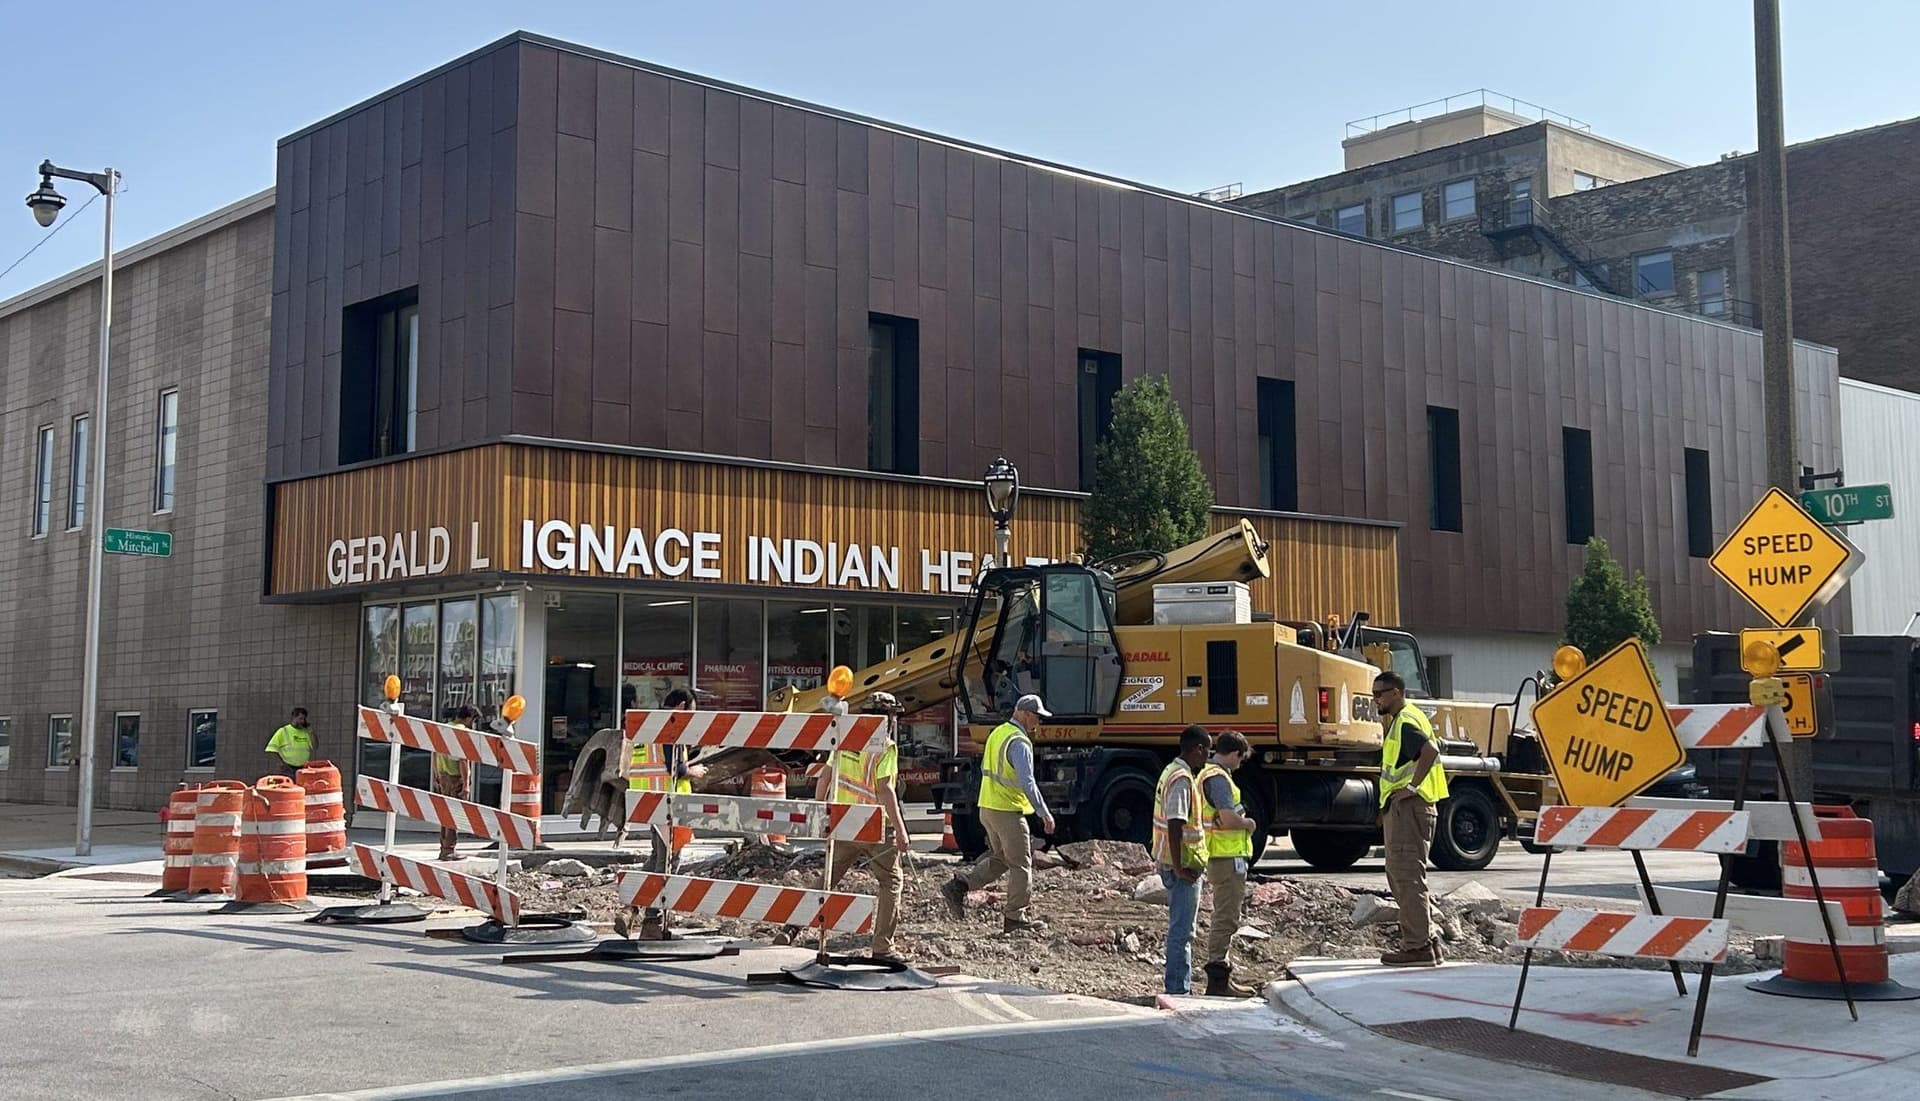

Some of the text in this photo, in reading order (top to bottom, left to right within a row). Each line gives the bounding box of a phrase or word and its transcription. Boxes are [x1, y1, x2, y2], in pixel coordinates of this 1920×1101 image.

[1823, 493, 1859, 517] 10TH
[1876, 494, 1890, 508] ST
[118, 538, 159, 554] Mitchell
[327, 521, 490, 585] GERALD L
[522, 519, 721, 579] IGNACE
[748, 535, 899, 589] INDIAN
[1743, 533, 1813, 556] SPEED
[1749, 565, 1812, 587] HUMP
[624, 662, 684, 671] MEDICAL CLINIC
[1122, 651, 1170, 662] RADALL
[704, 664, 746, 673] PHARMACY
[768, 665, 822, 674] FITNESS CENTER
[1576, 684, 1654, 732] SPEED
[1563, 735, 1634, 782] HUMP
[924, 771, 941, 781] DENT
